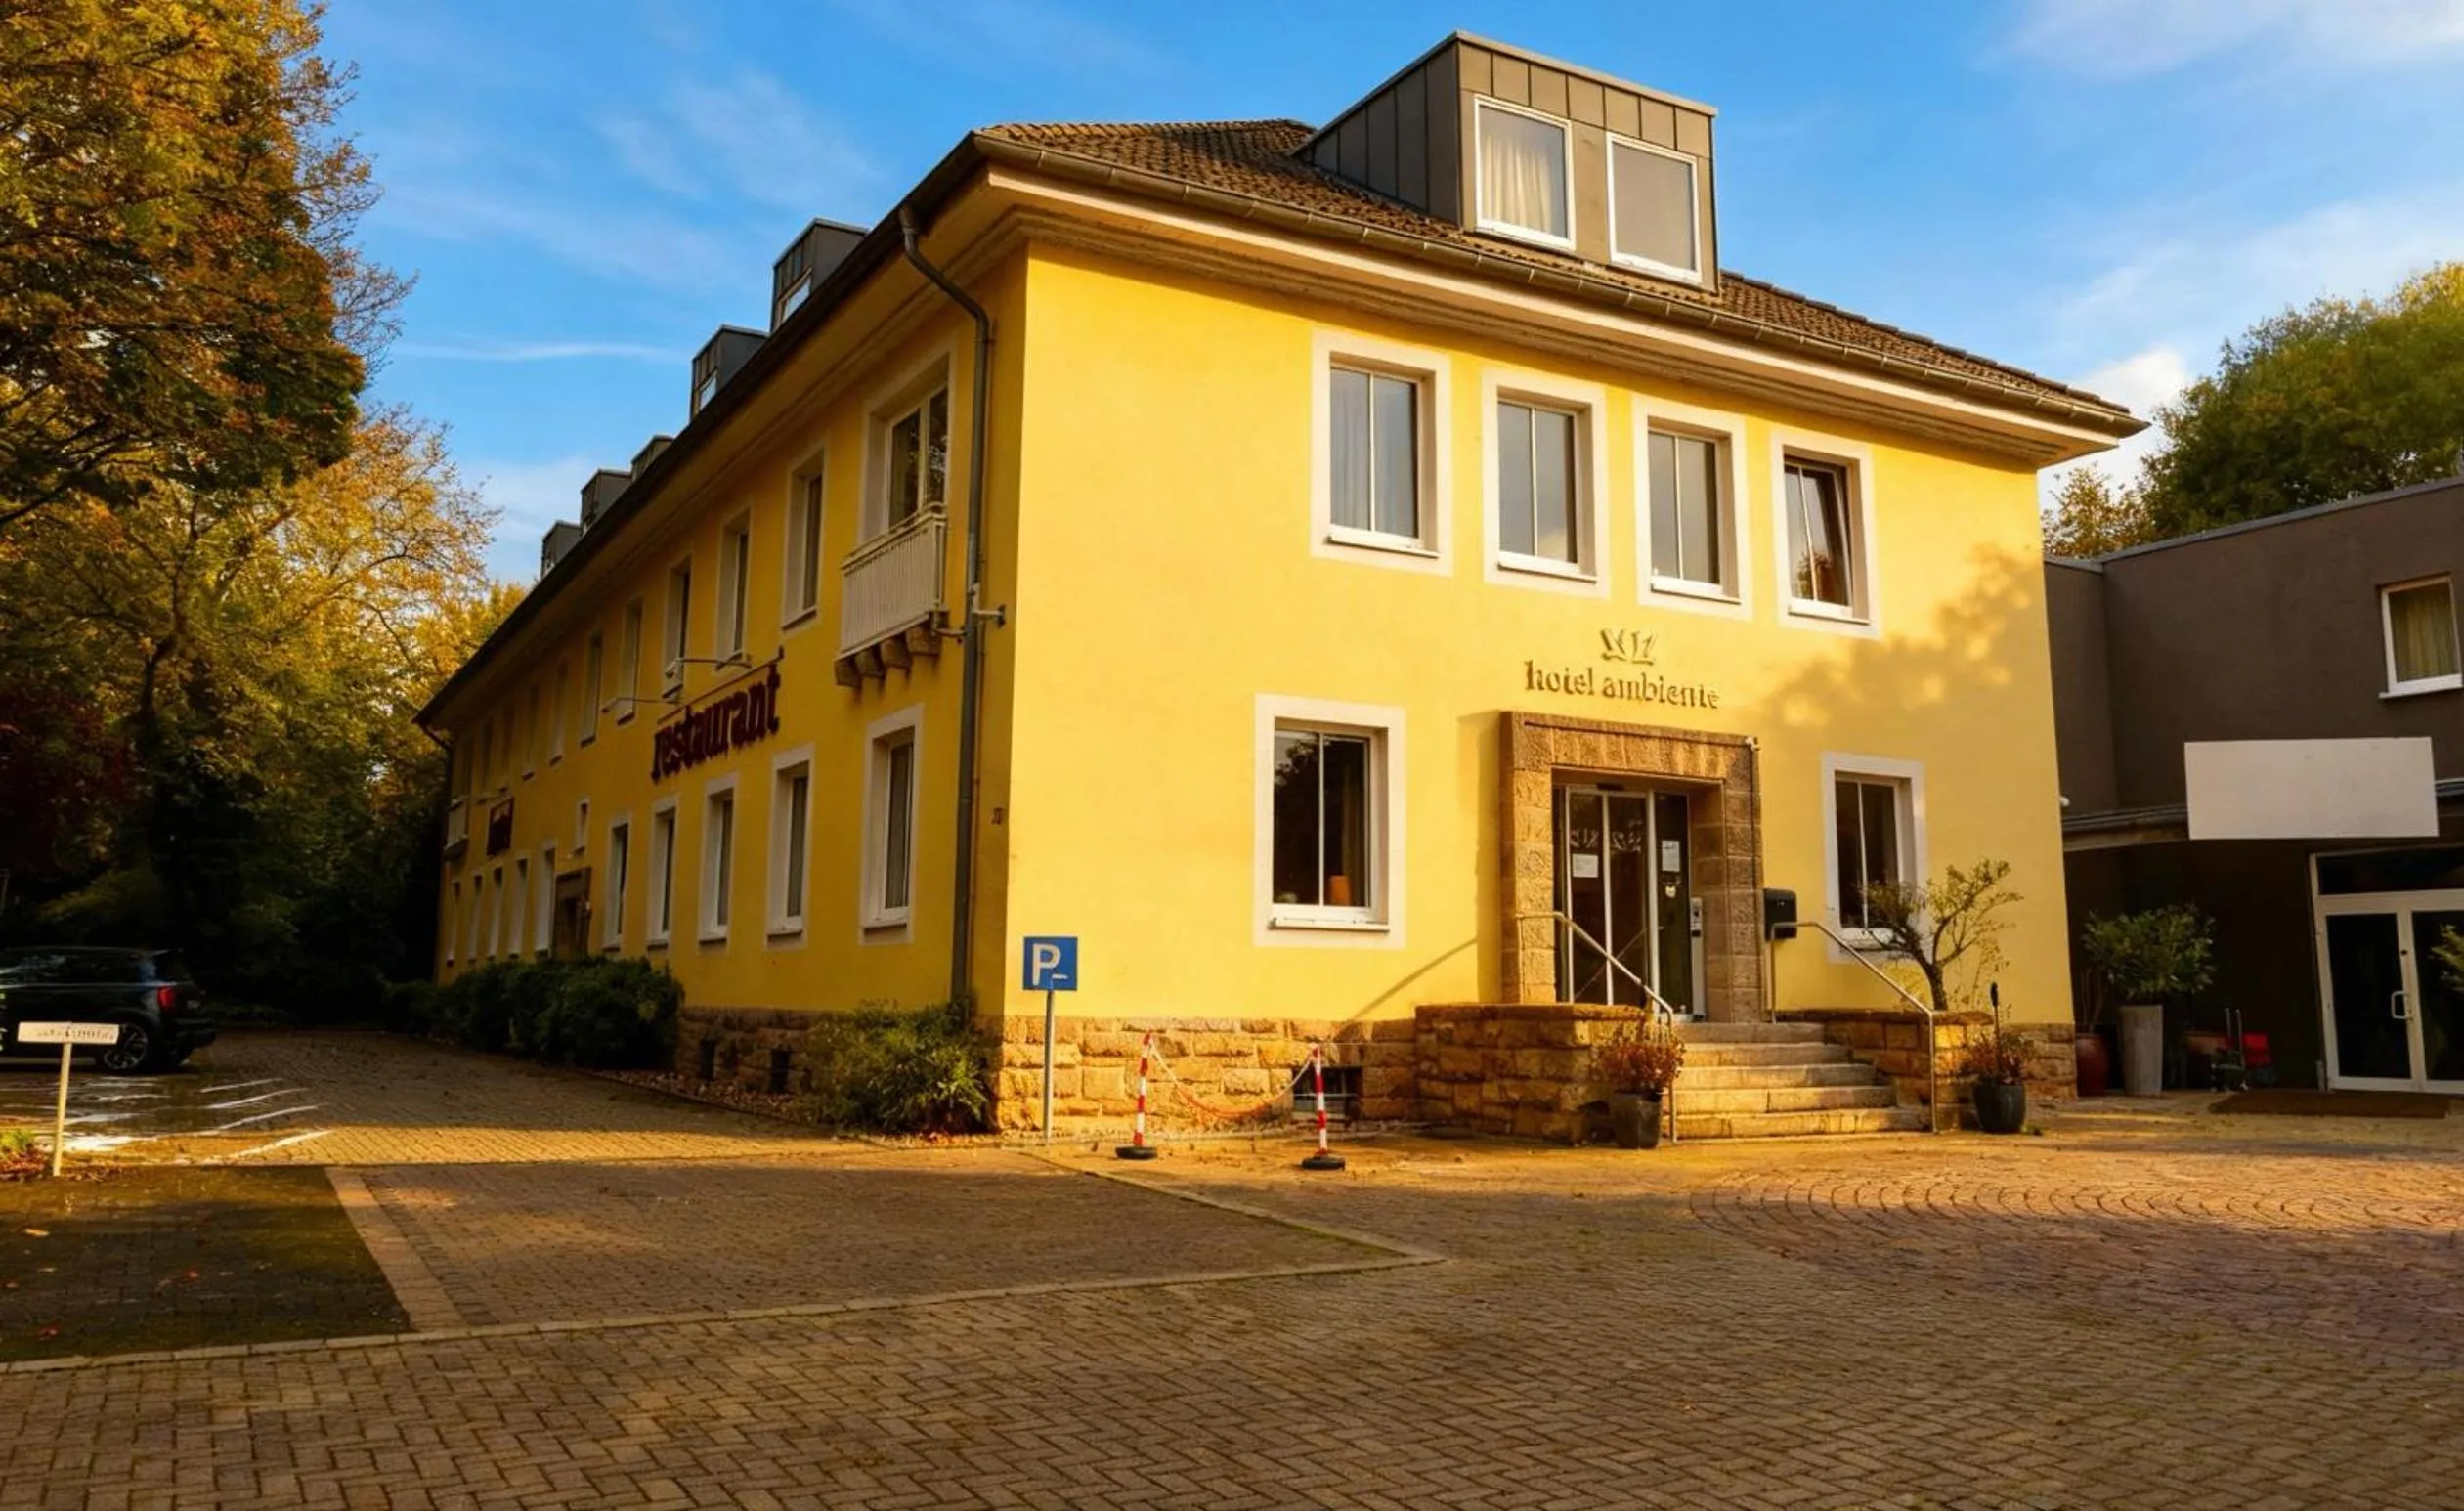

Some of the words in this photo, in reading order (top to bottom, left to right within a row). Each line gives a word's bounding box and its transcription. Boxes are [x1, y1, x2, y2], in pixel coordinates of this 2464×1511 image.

[1524, 659, 1595, 696] hotel
[1602, 672, 1720, 709] ambiente
[652, 664, 780, 784] restaurant
[1032, 943, 1061, 986] P
